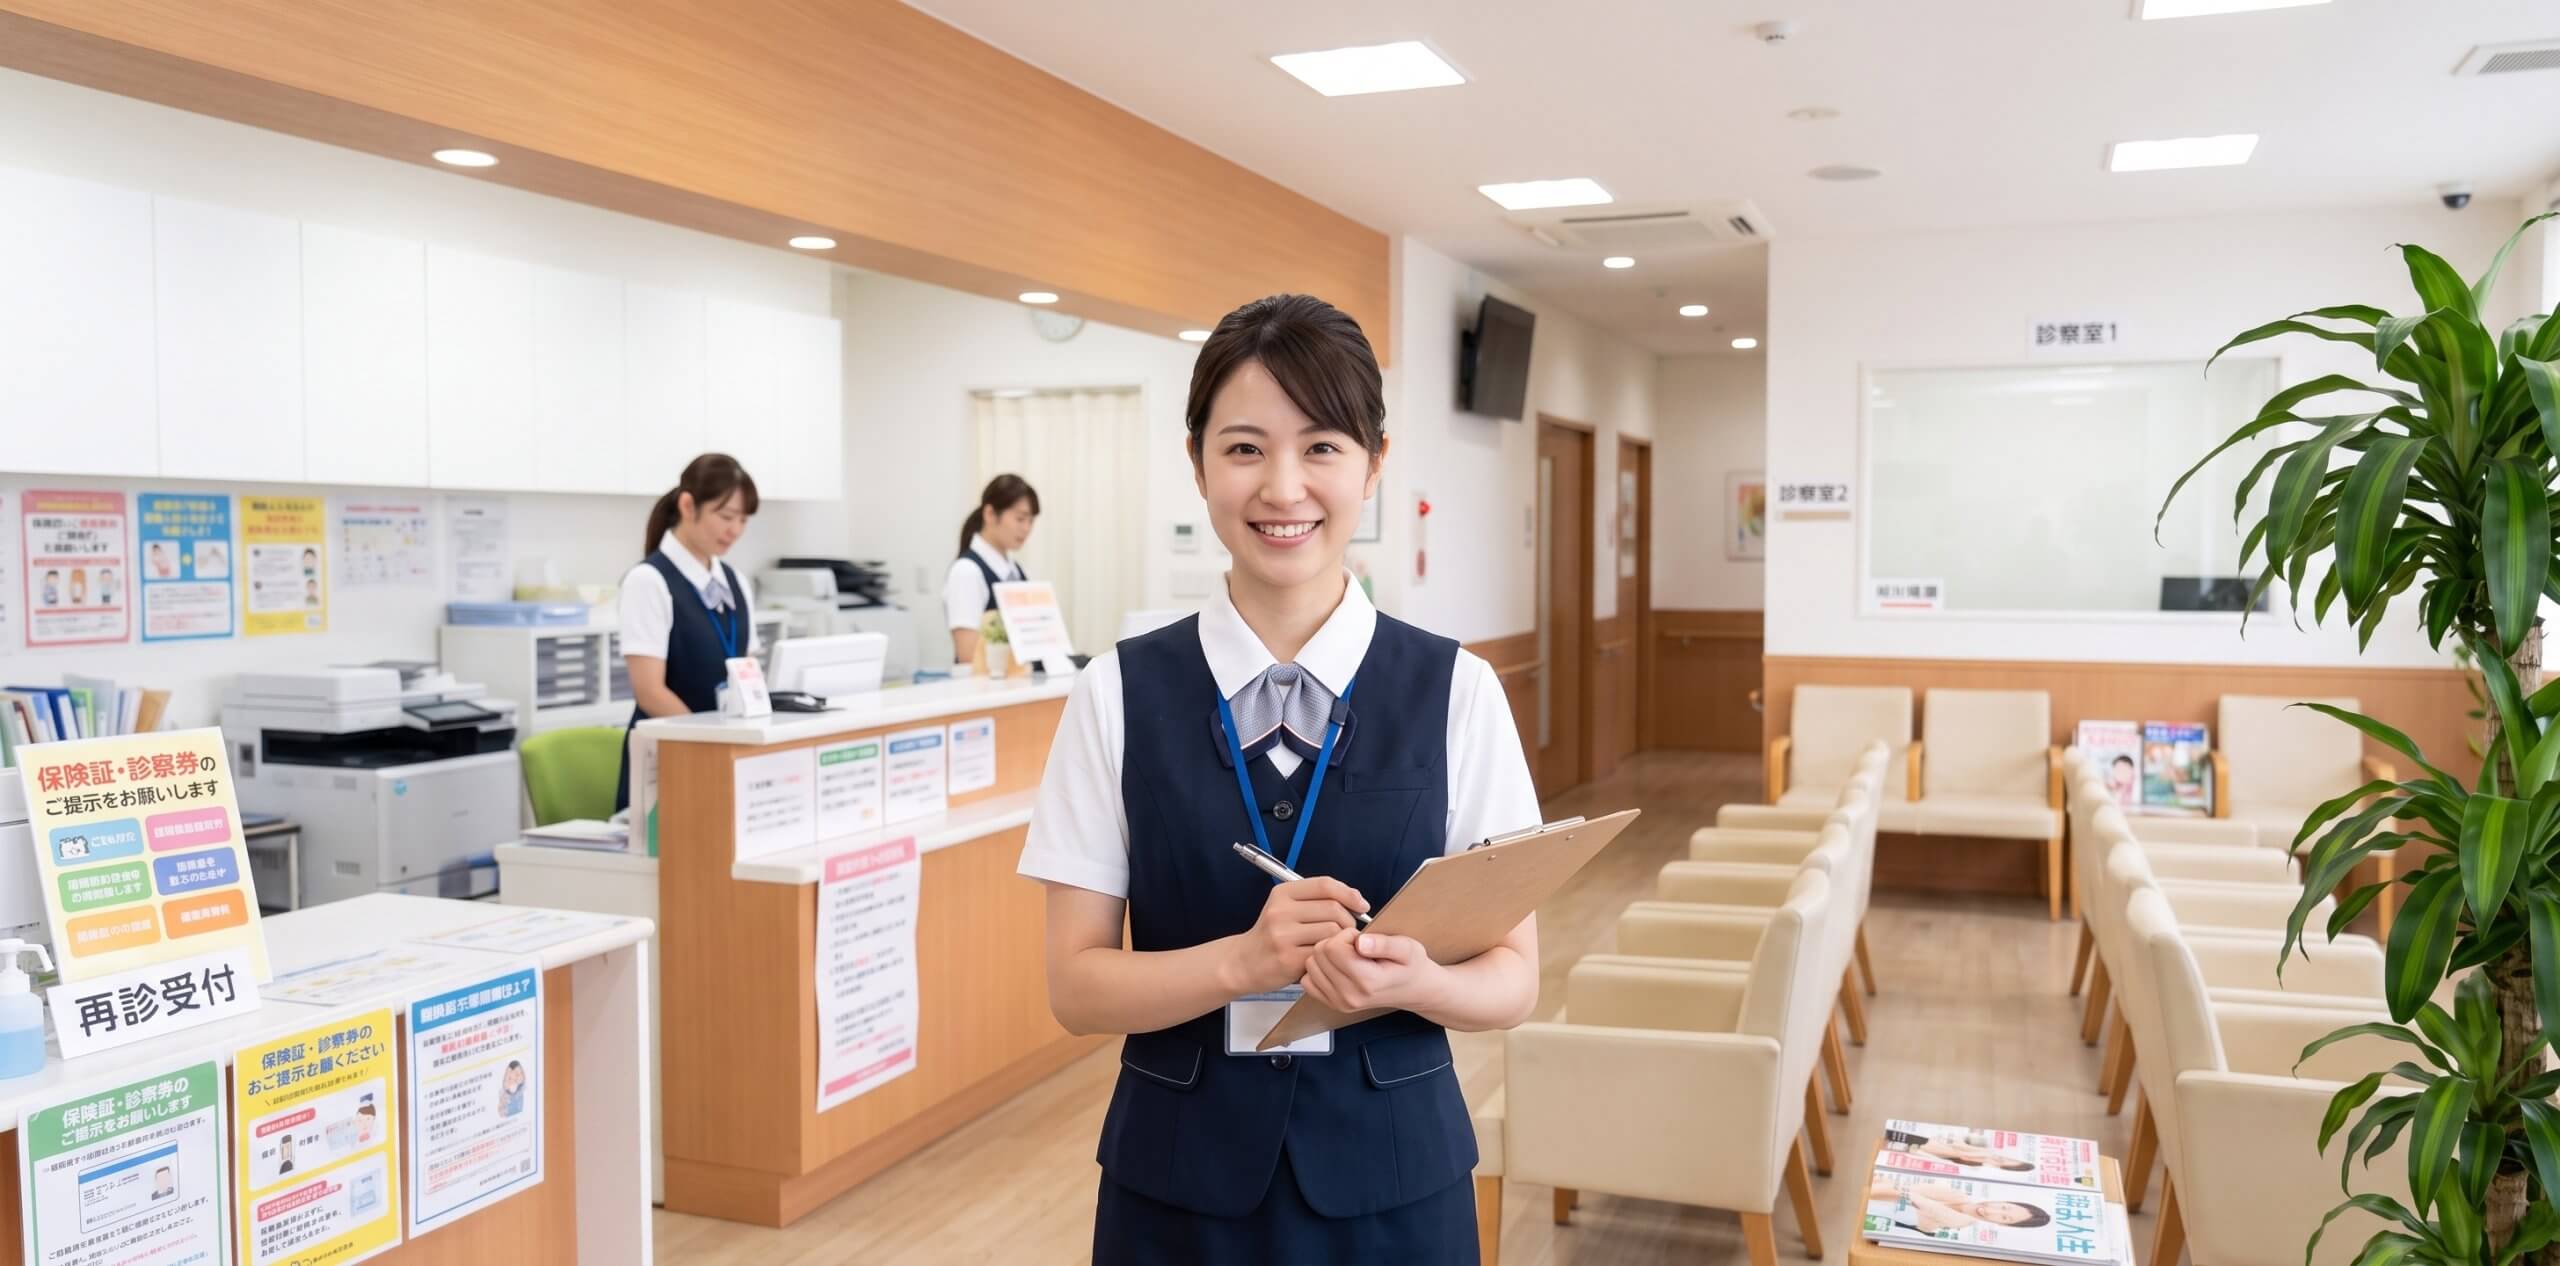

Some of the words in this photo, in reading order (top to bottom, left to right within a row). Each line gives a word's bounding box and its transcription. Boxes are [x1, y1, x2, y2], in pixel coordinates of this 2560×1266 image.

[2035, 322, 2117, 346] 診察室1
[1779, 484, 1848, 502] 診察室2
[37, 751, 216, 792] 保険証・診察券の
[45, 779, 219, 816] ご提示をお願いします
[75, 963, 235, 1037] 再診受付
[262, 1025, 373, 1070] 保険証・診察券の
[62, 1077, 189, 1129] 保険証・診察券の
